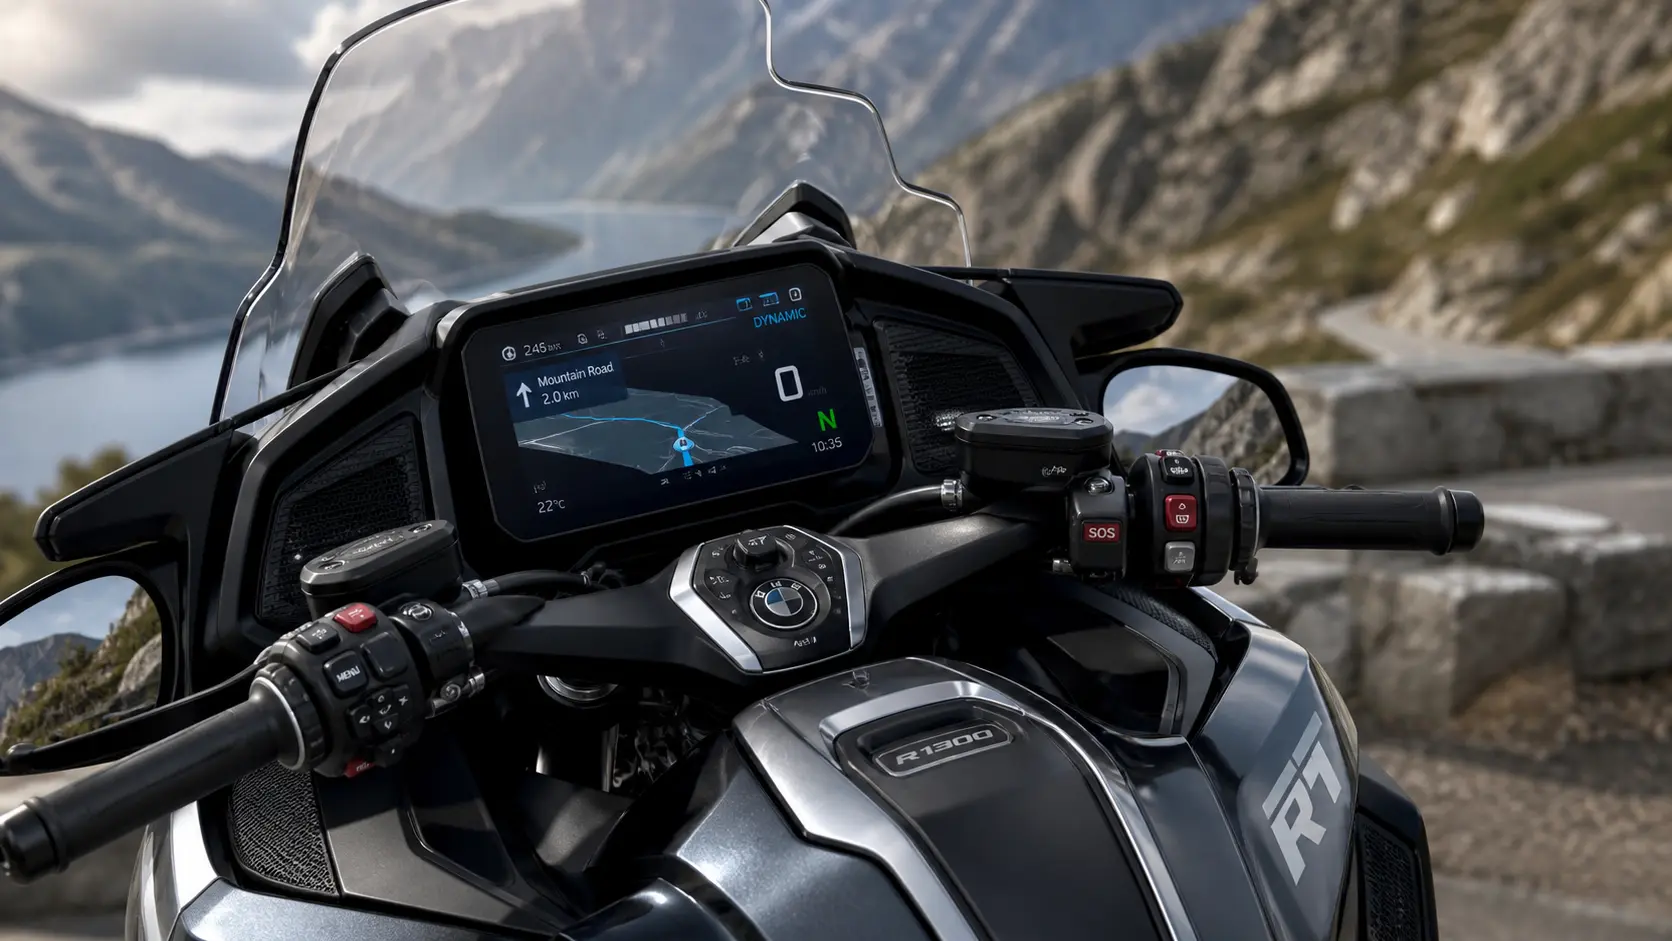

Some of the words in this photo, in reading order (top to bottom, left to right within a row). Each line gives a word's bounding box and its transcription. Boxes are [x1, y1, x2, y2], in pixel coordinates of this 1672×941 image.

[753, 307, 807, 329] DYNAMIC
[537, 368, 587, 388] Mountain
[587, 360, 615, 377] Road
[774, 365, 803, 402] 0
[541, 390, 562, 406] 2.0
[562, 389, 580, 401] km
[817, 408, 838, 432] N
[811, 436, 843, 453] 10:35
[537, 499, 566, 514] 22°C
[1088, 527, 1116, 539] SOS
